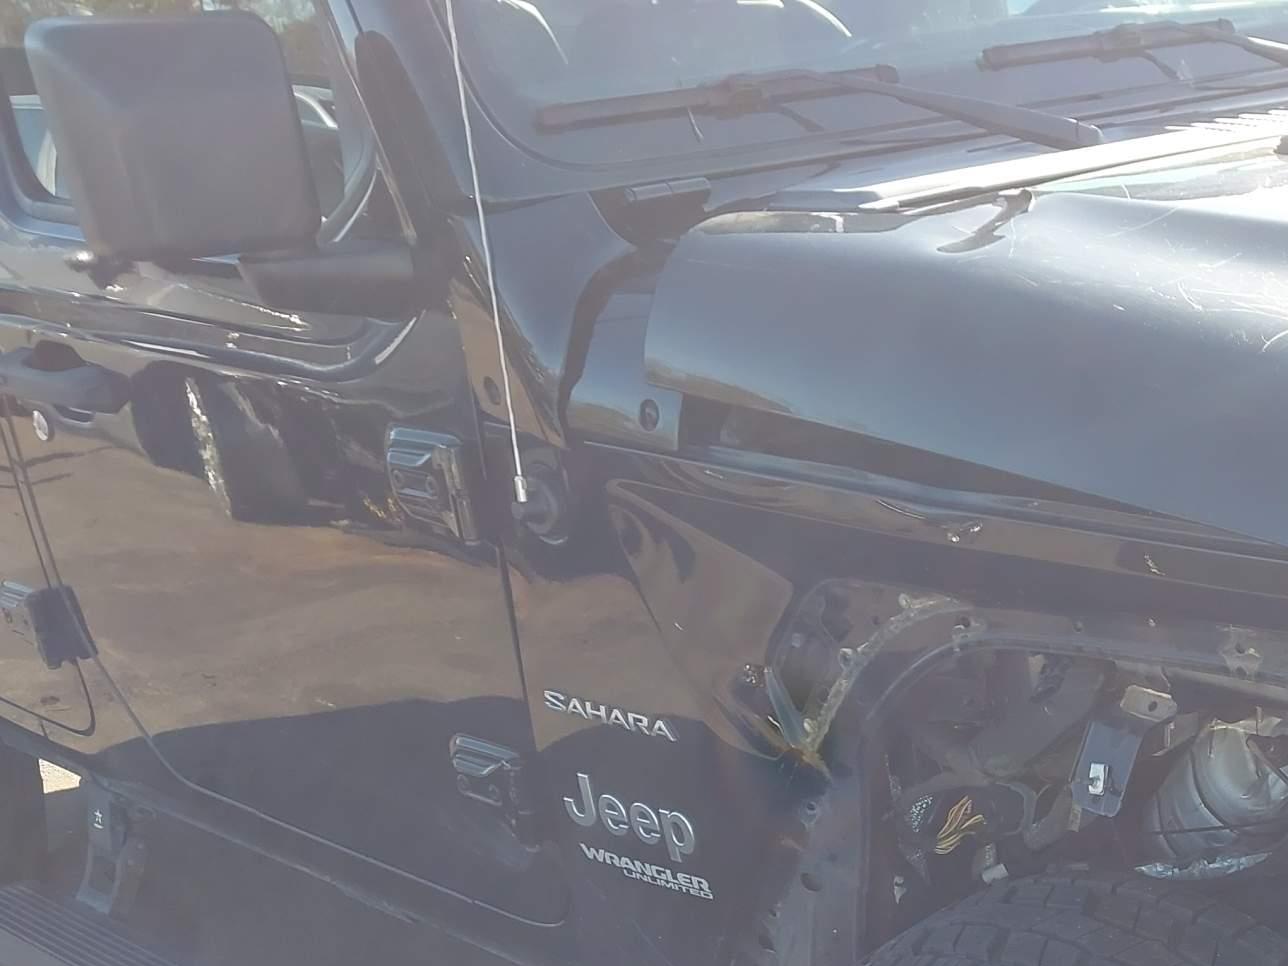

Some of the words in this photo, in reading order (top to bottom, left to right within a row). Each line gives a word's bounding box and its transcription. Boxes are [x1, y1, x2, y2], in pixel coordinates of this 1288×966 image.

[543, 689, 678, 742] SAHARA
[563, 772, 696, 863] Jeep
[578, 842, 713, 894] WRANGLER
[623, 869, 714, 900] UNLIMITED
